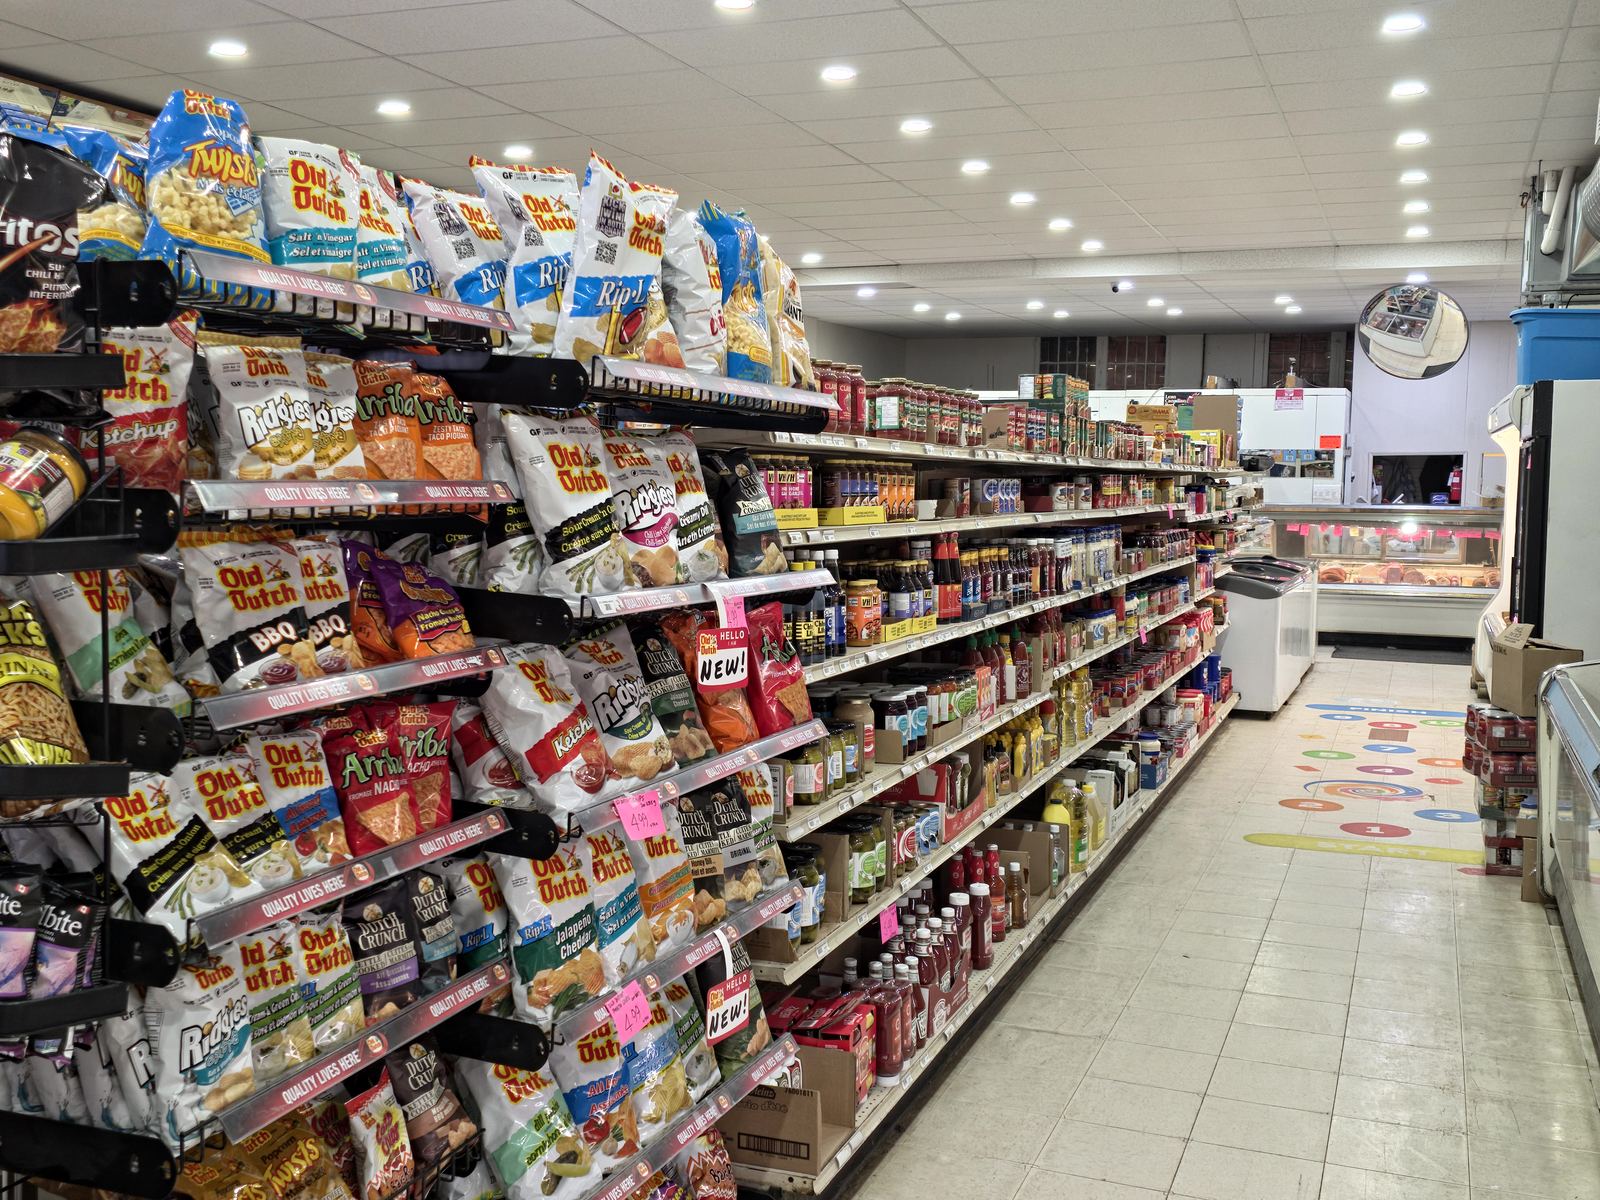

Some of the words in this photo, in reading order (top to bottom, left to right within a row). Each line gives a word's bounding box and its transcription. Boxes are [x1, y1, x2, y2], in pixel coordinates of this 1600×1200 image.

[183, 140, 259, 188] Twists
[290, 159, 327, 191] Old
[502, 171, 513, 179] GF
[294, 186, 347, 223] Dutch
[522, 194, 551, 213] Old
[534, 213, 577, 232] Dutch
[0, 217, 79, 256] itos
[288, 232, 312, 243] Salt
[322, 233, 353, 244] Vinegar
[628, 226, 664, 257] Dutch
[292, 247, 308, 257] Sel
[309, 247, 322, 256] et
[321, 248, 352, 258] vinaigre
[26, 269, 51, 279] CHILI
[258, 269, 297, 287] QUALITY
[300, 278, 323, 294] LIVES
[322, 281, 346, 295] HERE
[424, 300, 450, 316] QUALITY
[452, 306, 469, 319] LIVES
[469, 309, 491, 323] HERE
[246, 359, 290, 378] Dutch
[238, 391, 312, 449] Ridgies
[433, 425, 451, 433] ZESTY
[429, 433, 445, 441] TACO
[529, 428, 541, 437] GF
[549, 443, 584, 468] Old
[605, 442, 630, 456] Old
[614, 453, 651, 470] Dutch
[558, 469, 610, 493] Dutch
[265, 487, 301, 500] QUALITY
[303, 487, 326, 499] LIVES
[327, 487, 350, 499] HERE
[425, 486, 453, 499] QUALITY
[455, 486, 471, 498] LIVES
[472, 486, 490, 498] HERE
[612, 480, 675, 526] Ridgies
[562, 520, 583, 537] Sour
[582, 512, 601, 527] Cream
[679, 511, 700, 527] Creamy
[561, 536, 591, 553] Crème
[590, 528, 605, 541] sure
[219, 566, 264, 589] Old
[228, 583, 297, 611] Dutch
[627, 598, 647, 609] QUALITY
[647, 595, 660, 607] LIVES
[660, 593, 674, 605] HERE
[861, 597, 872, 607] VH
[924, 589, 932, 598] VH
[416, 610, 440, 622] Nacho
[420, 617, 450, 632] Fromage
[250, 620, 298, 652] BBQ
[309, 614, 347, 645] BBQ
[700, 634, 711, 645] Old
[720, 630, 745, 640] HELLO
[644, 648, 676, 664] DUTCH
[700, 646, 717, 655] Dutch
[422, 661, 448, 677] QUALITY
[449, 659, 465, 671] LIVES
[465, 655, 483, 668] HERE
[583, 671, 594, 680] GF
[647, 658, 685, 675] CRUNCH
[700, 650, 746, 682] NEW!
[268, 689, 303, 709] QUALITY
[304, 685, 326, 701] LIVES
[326, 681, 350, 697] HERE
[400, 714, 428, 725] Dutch
[1350, 706, 1427, 715] FINISH
[781, 735, 798, 748] QUALITY
[798, 732, 807, 742] LIVES
[806, 728, 816, 739] HERE
[264, 744, 303, 766] Old
[271, 764, 325, 789] Dutch
[705, 764, 724, 779] QUALITY
[724, 761, 735, 773] LIVES
[735, 757, 747, 769] HERE
[195, 769, 241, 799] Old
[104, 790, 149, 821] Old
[713, 799, 739, 815] DUTCH
[1298, 801, 1324, 809] 2
[713, 809, 747, 826] CRUNCH
[179, 824, 201, 847] Onion
[233, 826, 263, 844] Cream
[265, 834, 276, 844] et
[418, 837, 449, 856] QUALITY
[448, 830, 466, 846] LIVES
[465, 824, 483, 840] HERE
[1366, 826, 1385, 834] 1
[730, 847, 752, 859] ORIGINAL
[1316, 841, 1428, 857] START
[530, 855, 566, 879] Old
[592, 853, 633, 884] Dutch
[147, 870, 175, 893] Crème
[537, 874, 590, 904] Dutch
[261, 895, 300, 918] QUALITY
[300, 884, 323, 904] LIVES
[322, 874, 346, 896] HERE
[760, 906, 774, 919] QUALITY
[773, 900, 784, 914] LIVES
[783, 894, 792, 908] HERE
[357, 911, 400, 935] DUTCH
[599, 906, 617, 924] Salt
[358, 922, 407, 951] CRUNCH
[555, 913, 592, 947] Jalapeño
[606, 921, 620, 935] Sel
[300, 926, 338, 953] Old
[559, 932, 592, 960] Cheddar
[685, 948, 704, 964] QUALITY
[702, 941, 715, 957] LIVES
[726, 975, 748, 991] HELLO
[430, 997, 456, 1017] QUALITY
[455, 987, 474, 1004] LIVES
[472, 977, 490, 995] HERE
[120, 1010, 135, 1022] GF
[708, 992, 749, 1037] NEW!
[178, 994, 251, 1075] Ridgies
[752, 1065, 767, 1082] QUALITY
[766, 1058, 776, 1073] LIVES
[774, 1050, 785, 1066] HERE
[281, 1079, 317, 1105] QUALITY
[316, 1065, 341, 1086] LIVES
[339, 1051, 363, 1074] HERE
[754, 1087, 774, 1098] einz
[677, 1125, 695, 1144] QUALITY
[694, 1115, 708, 1133] LIVES
[706, 1105, 719, 1122] HERE
[261, 1135, 297, 1165] Popcorn
[264, 1137, 320, 1195] Twists
[620, 1175, 636, 1192] HERE
